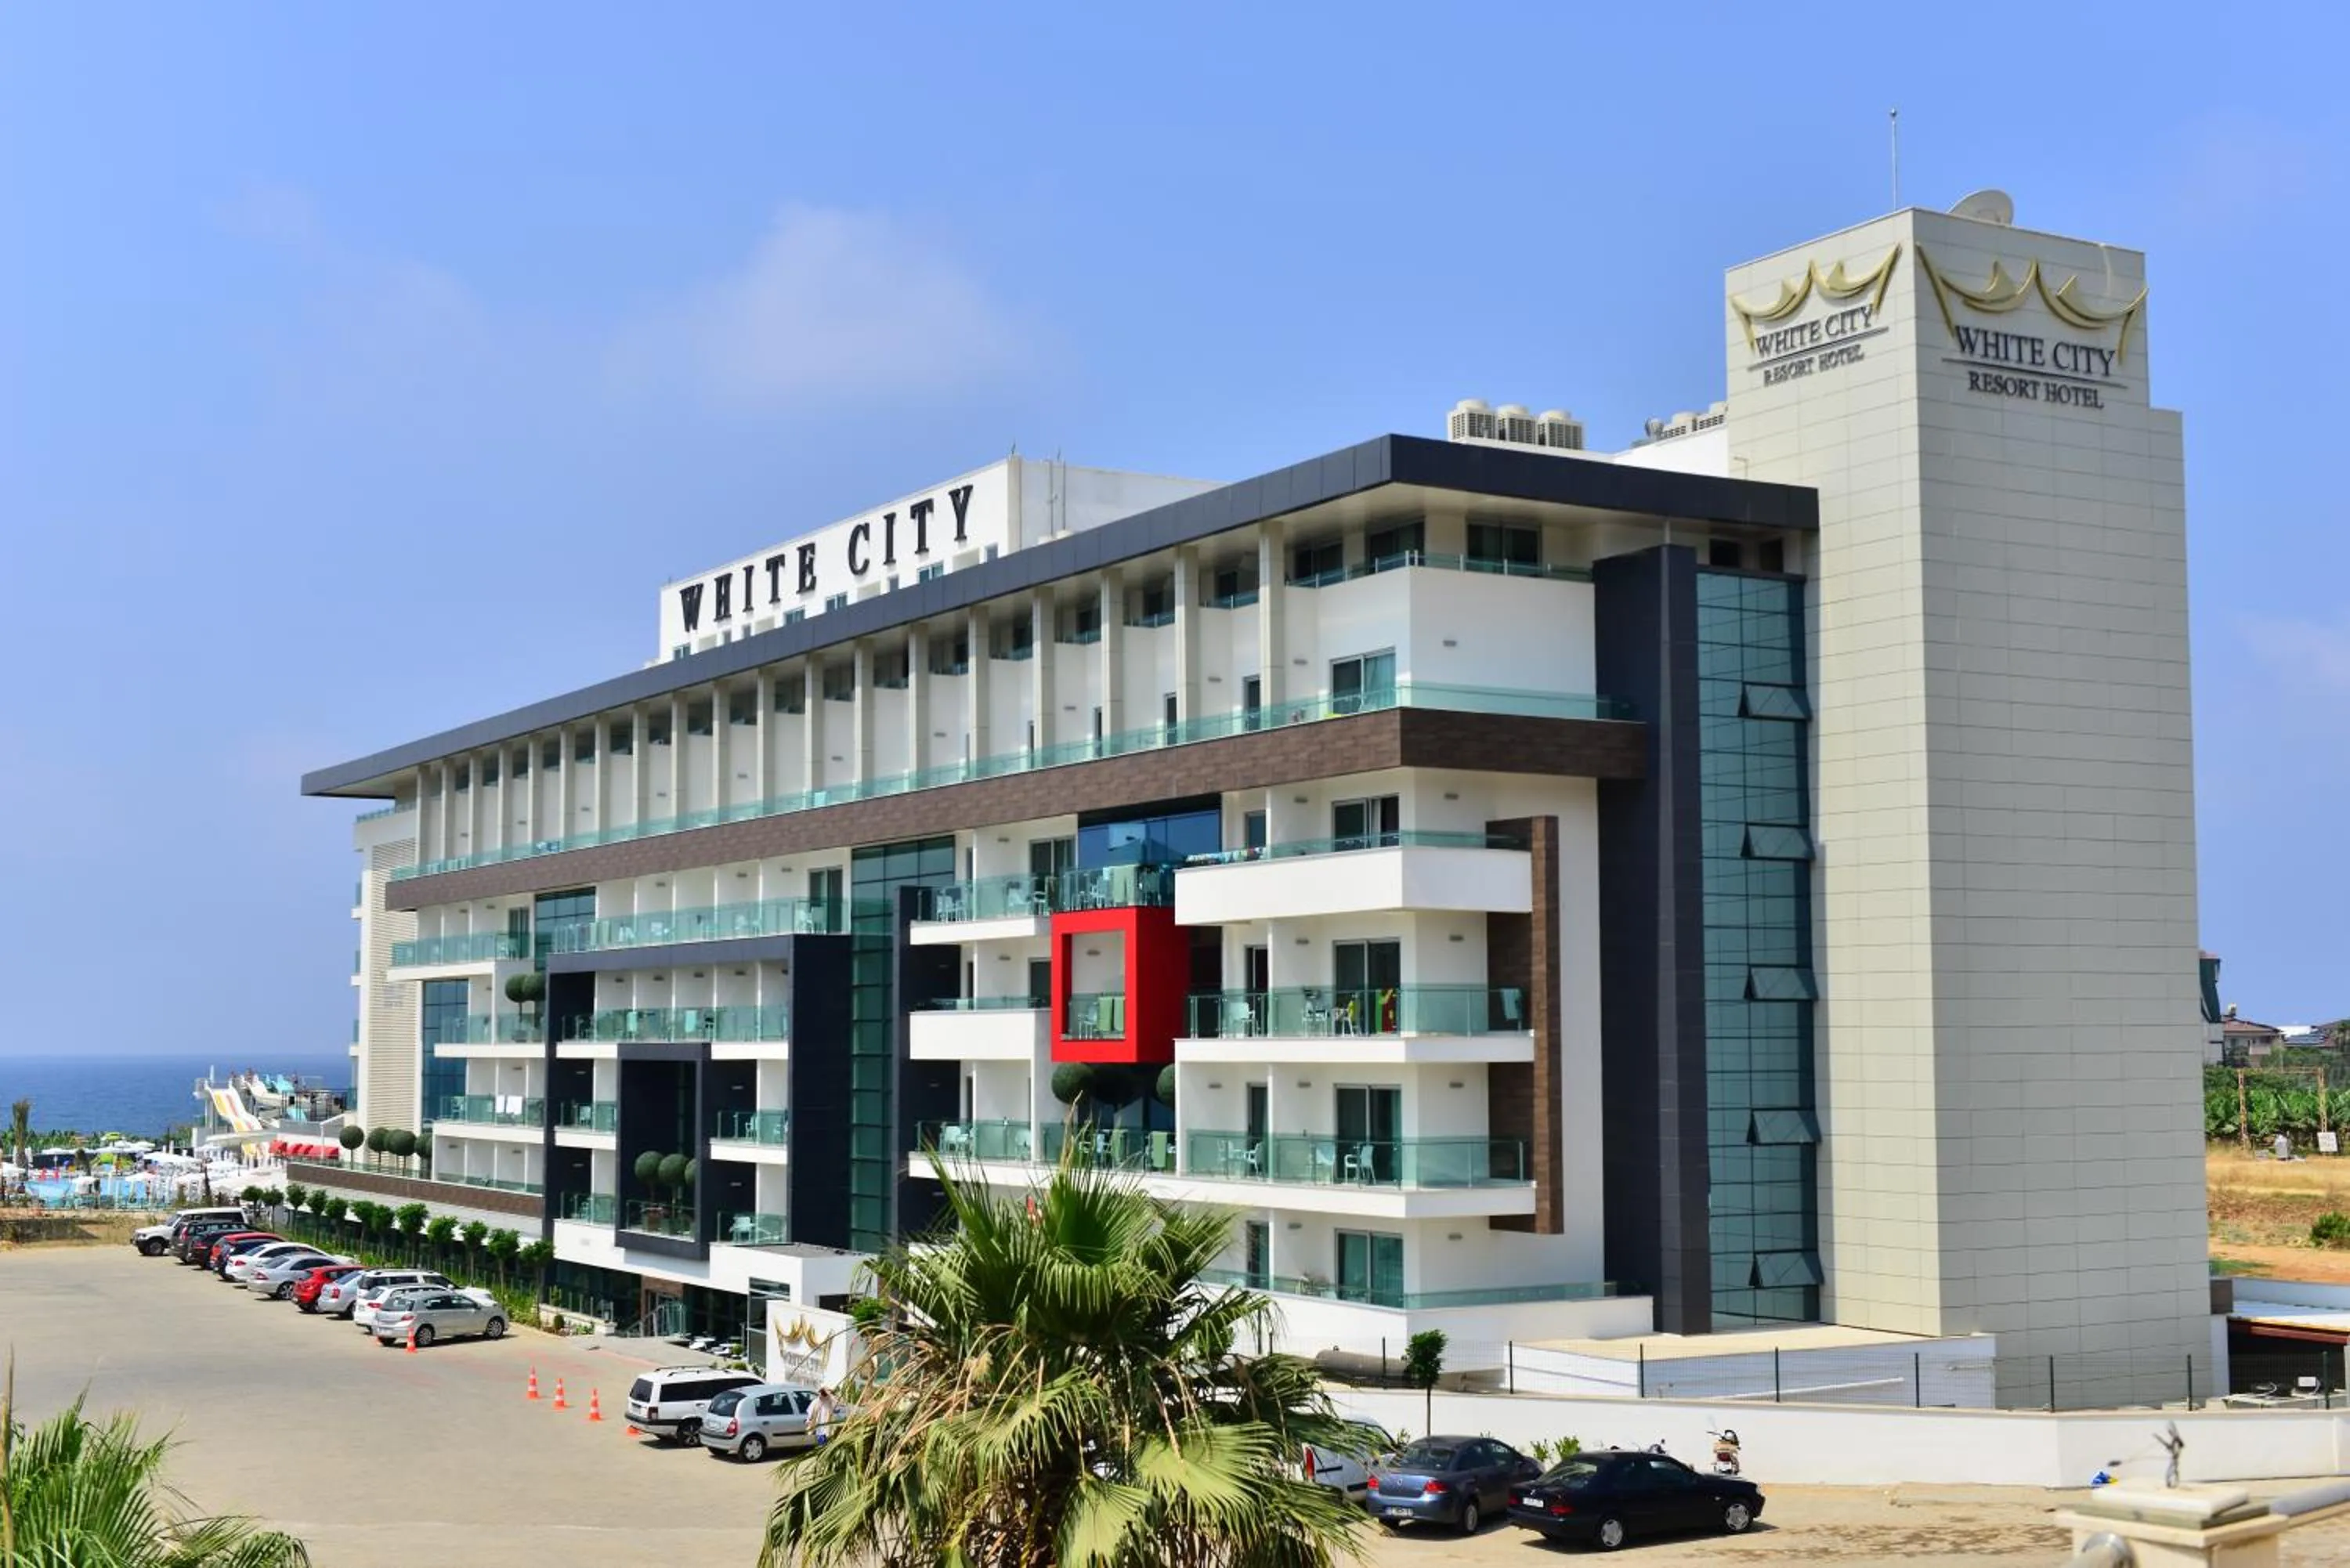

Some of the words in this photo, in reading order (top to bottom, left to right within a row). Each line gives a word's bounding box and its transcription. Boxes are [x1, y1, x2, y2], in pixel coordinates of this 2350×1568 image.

[1755, 320, 1821, 357] WHITE
[1825, 303, 1873, 336] CITY
[1955, 325, 2045, 367] WHITE
[2053, 341, 2115, 377] CITY
[1764, 357, 1815, 386] RESORT
[1818, 344, 1864, 372] HOTEL
[1968, 370, 2040, 400] RESORT
[2044, 381, 2104, 410] HOTEL
[680, 543, 817, 632] WHITE
[848, 485, 974, 576] CITY
